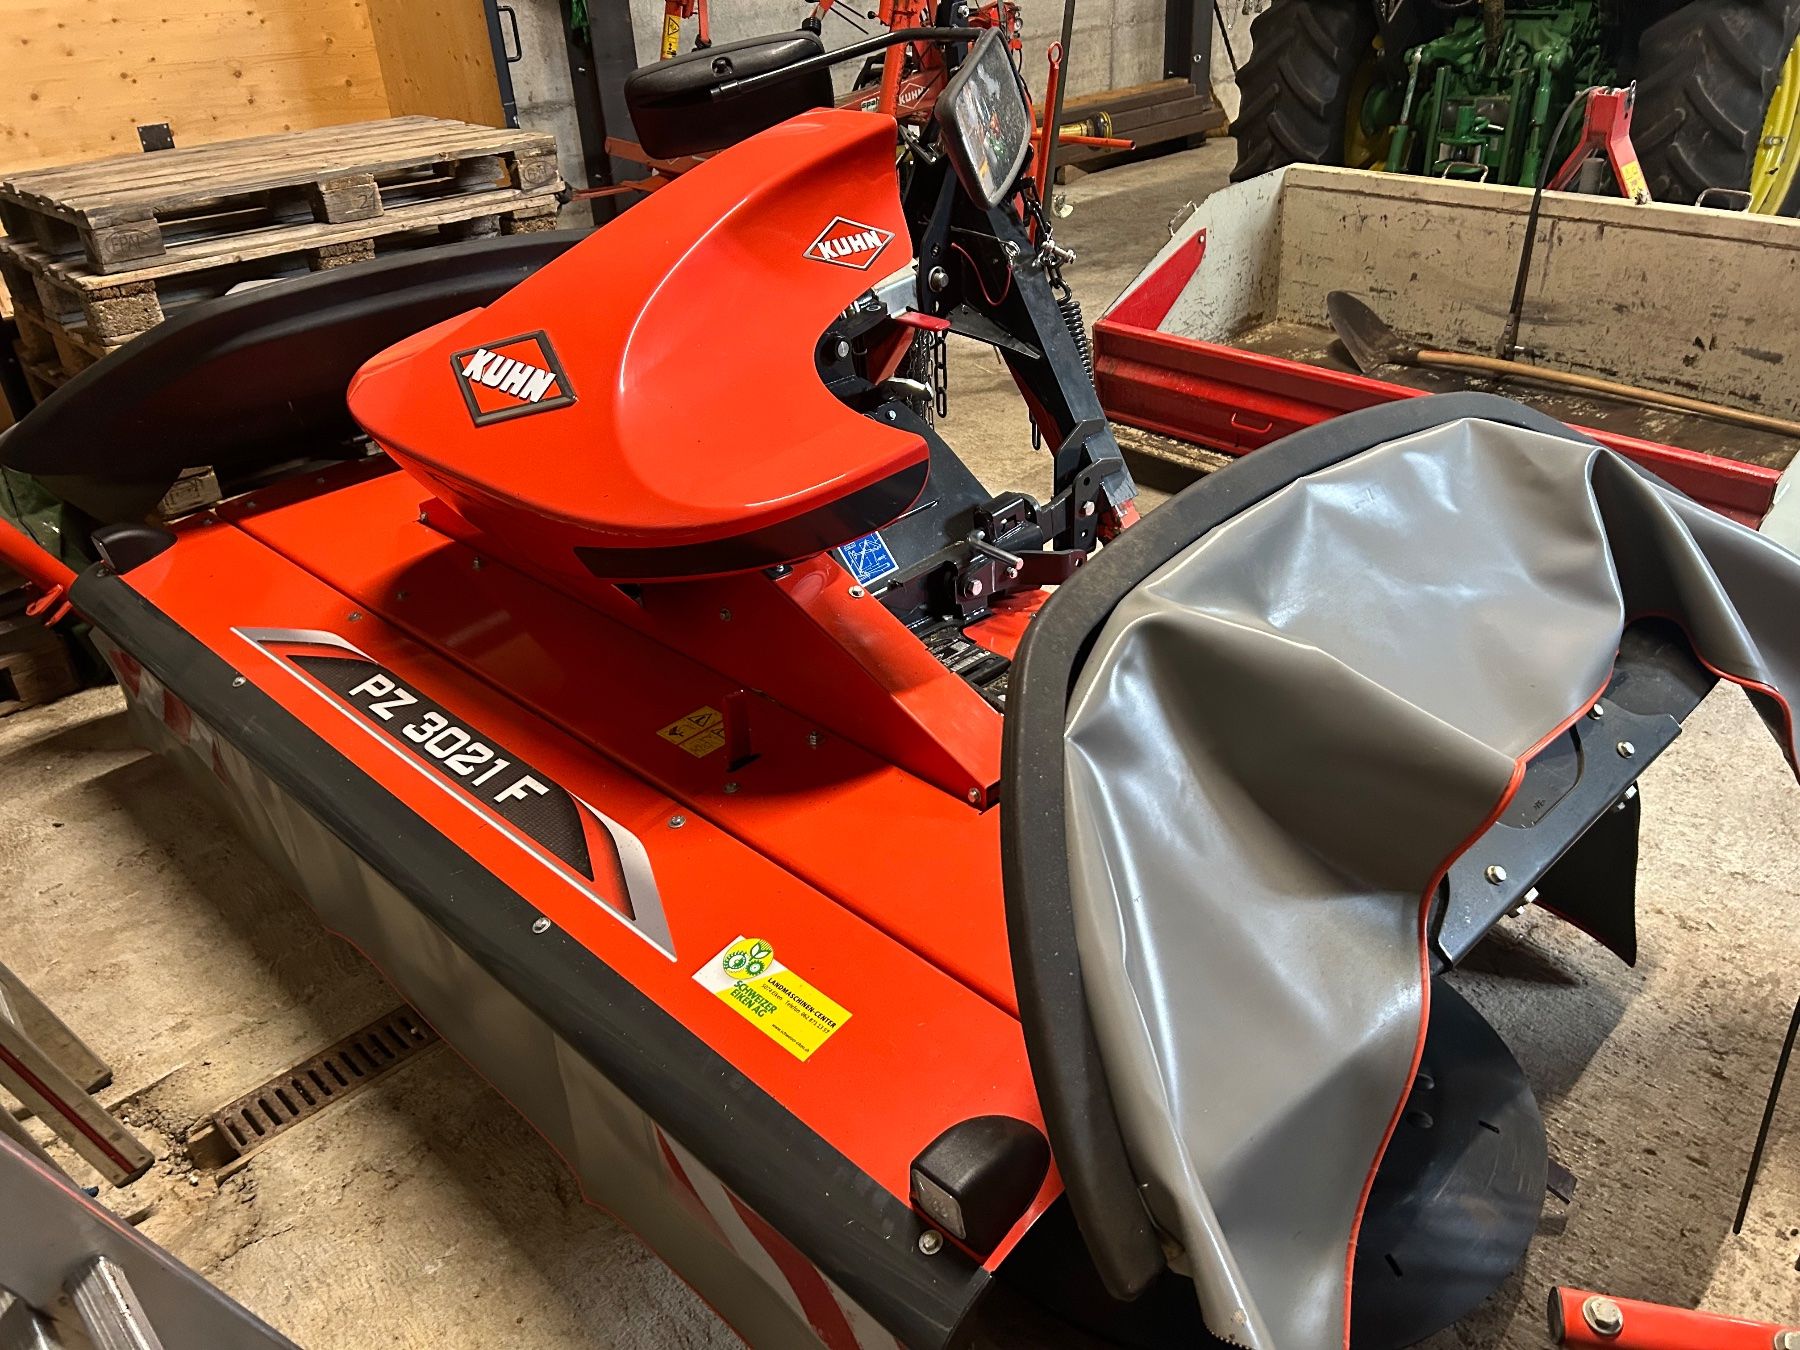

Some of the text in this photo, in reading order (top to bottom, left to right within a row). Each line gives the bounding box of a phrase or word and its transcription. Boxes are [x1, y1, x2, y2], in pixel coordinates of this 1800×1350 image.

[817, 230, 882, 260] KUHN
[462, 348, 556, 403] KUHN
[348, 673, 549, 804] PZ 3021 F
[730, 989, 766, 1018] EIKEN AG
[733, 980, 778, 1015] SCHWEIZER
[767, 977, 837, 1028] LANDMASCHINEN-CENTER
